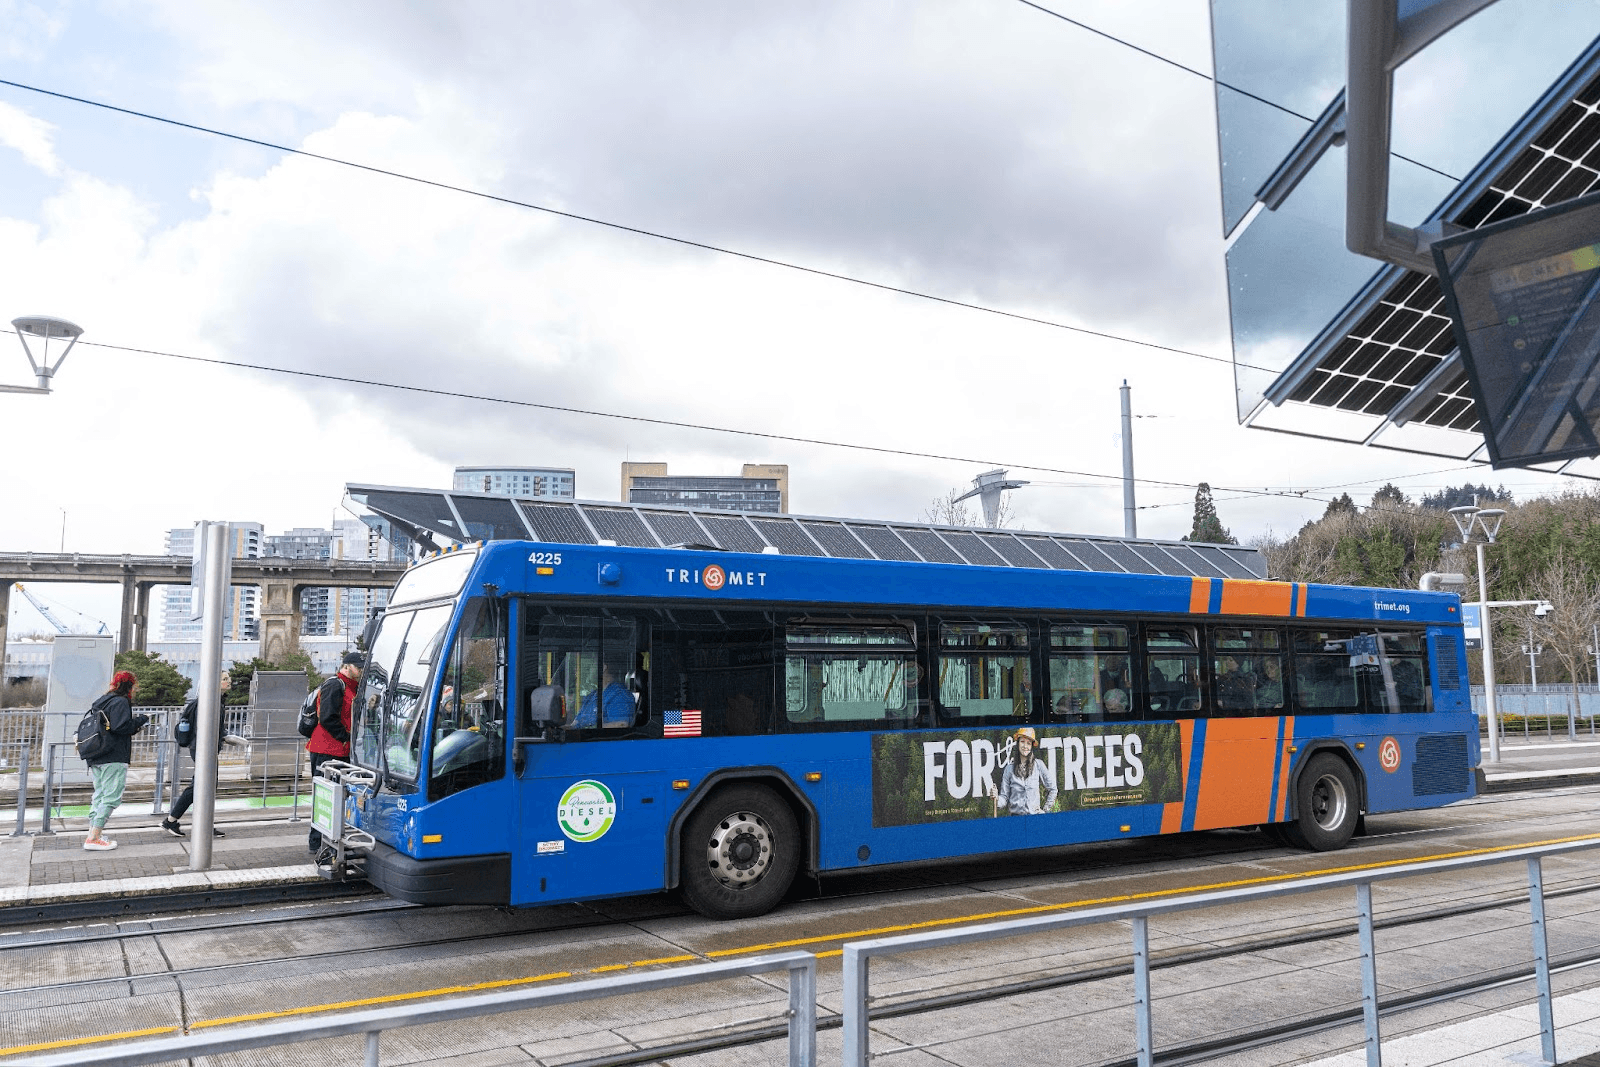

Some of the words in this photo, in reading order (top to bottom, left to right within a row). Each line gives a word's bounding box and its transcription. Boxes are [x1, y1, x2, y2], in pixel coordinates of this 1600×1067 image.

[528, 553, 562, 565] 4225
[1374, 601, 1410, 614] trimet.org
[923, 738, 996, 802] FOR
[1039, 733, 1145, 791] TREES
[559, 806, 614, 817] DIESEL
